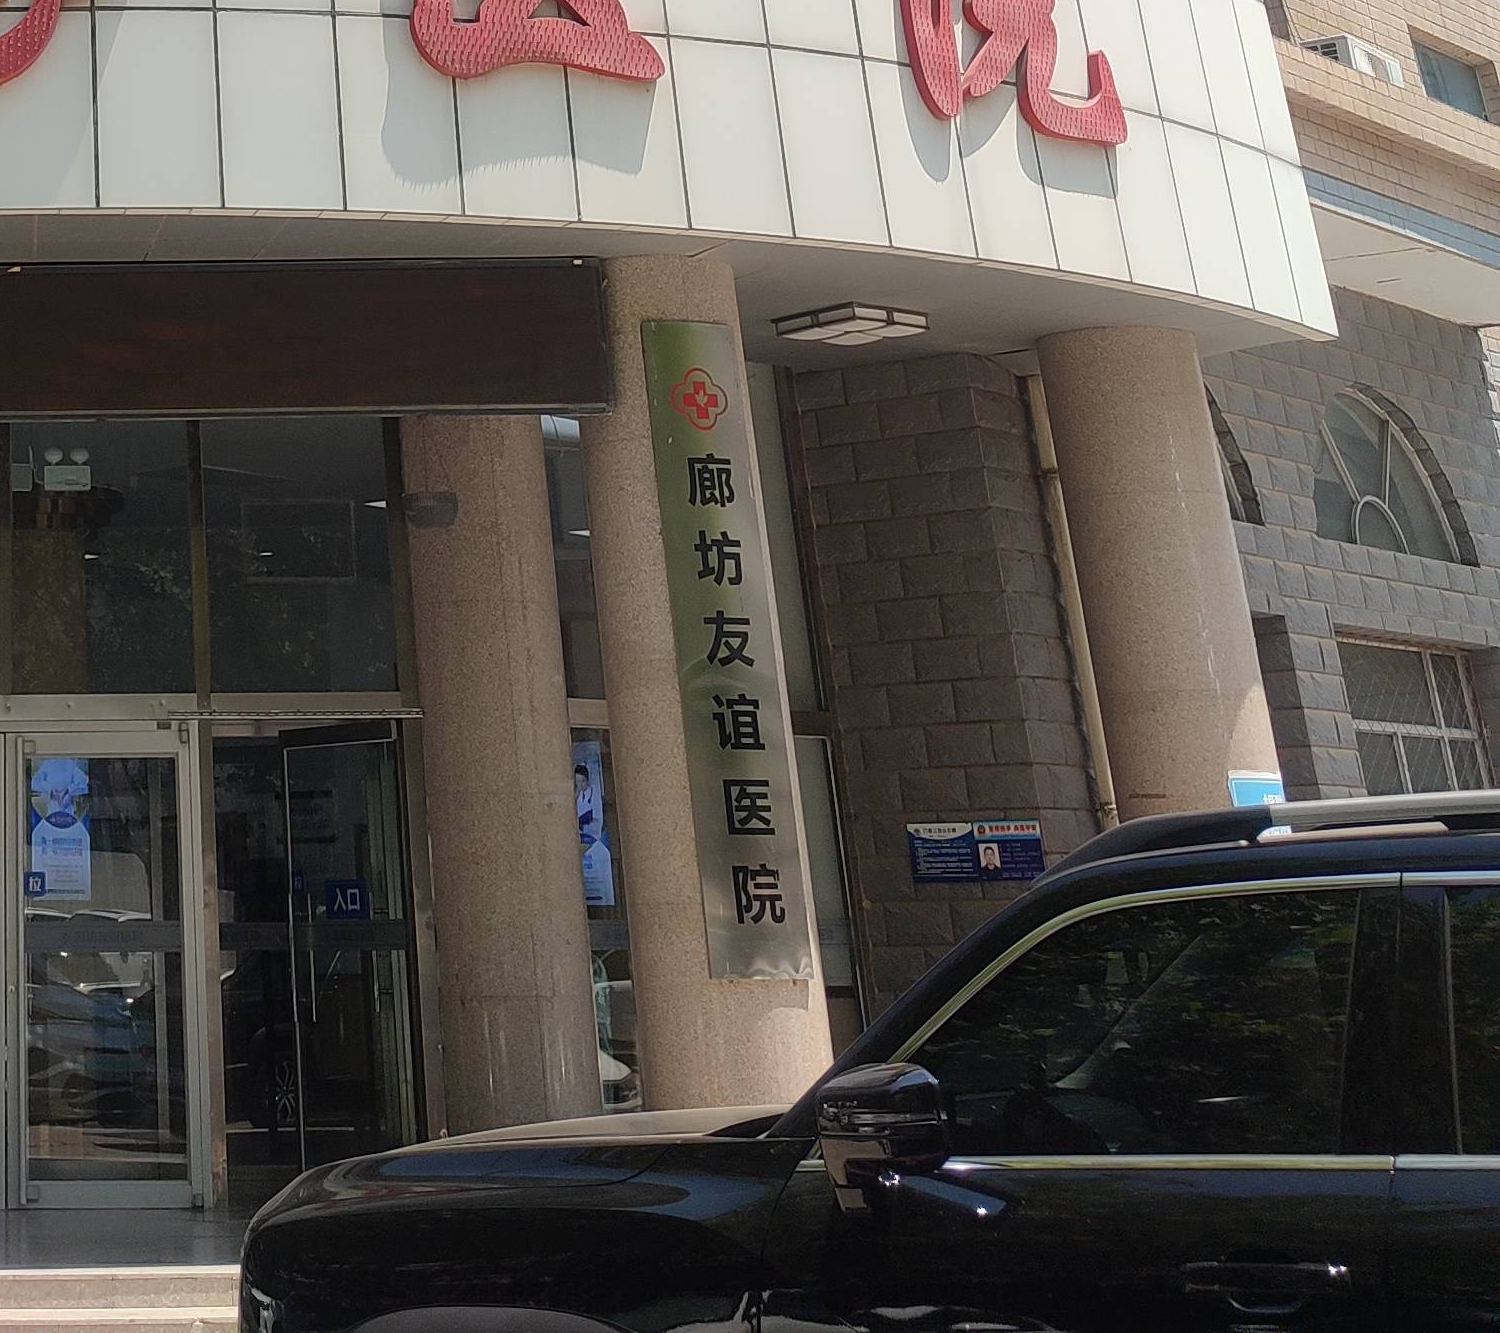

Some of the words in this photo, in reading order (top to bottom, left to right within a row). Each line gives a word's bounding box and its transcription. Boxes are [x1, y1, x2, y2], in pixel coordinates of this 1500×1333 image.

[686, 452, 786, 926] 廊坊友谊医院
[28, 876, 42, 892] 拉
[333, 886, 361, 912] 入口
